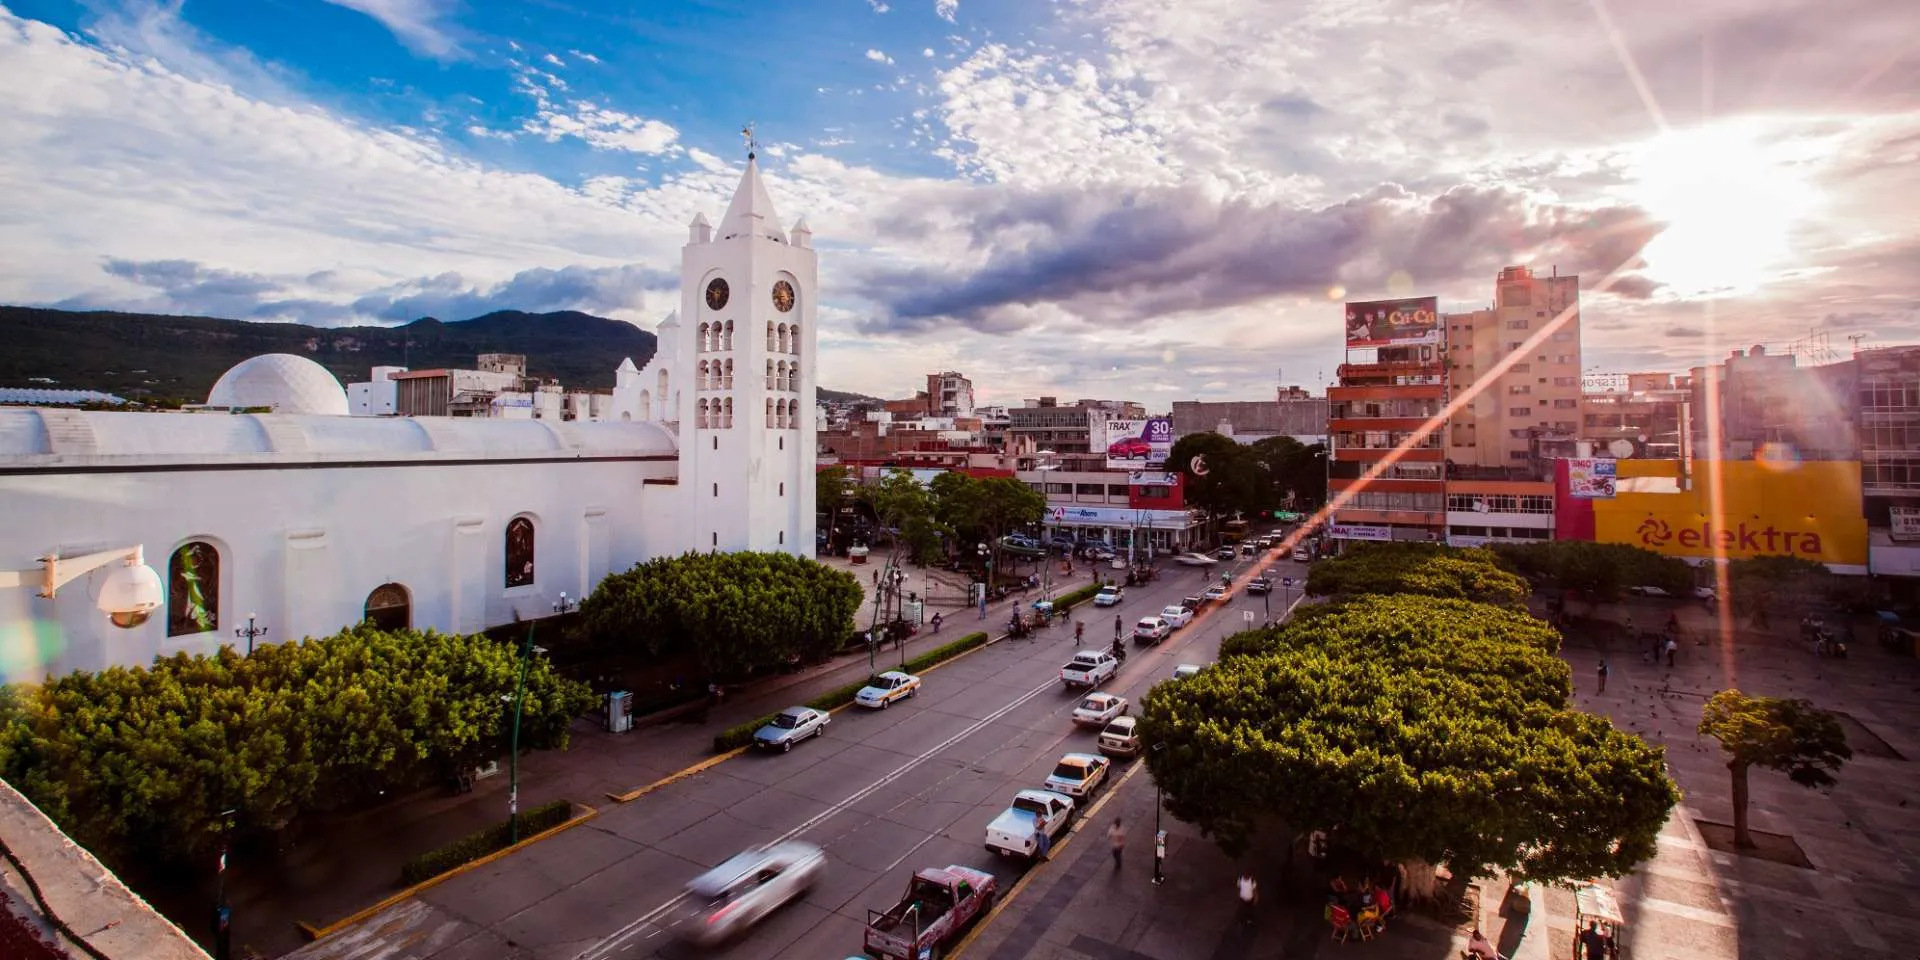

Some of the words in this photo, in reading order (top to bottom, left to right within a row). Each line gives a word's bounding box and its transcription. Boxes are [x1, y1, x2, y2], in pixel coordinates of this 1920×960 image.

[1108, 422, 1131, 431] TRAX
[1151, 421, 1169, 434] 30
[1678, 522, 1822, 554] elektra
